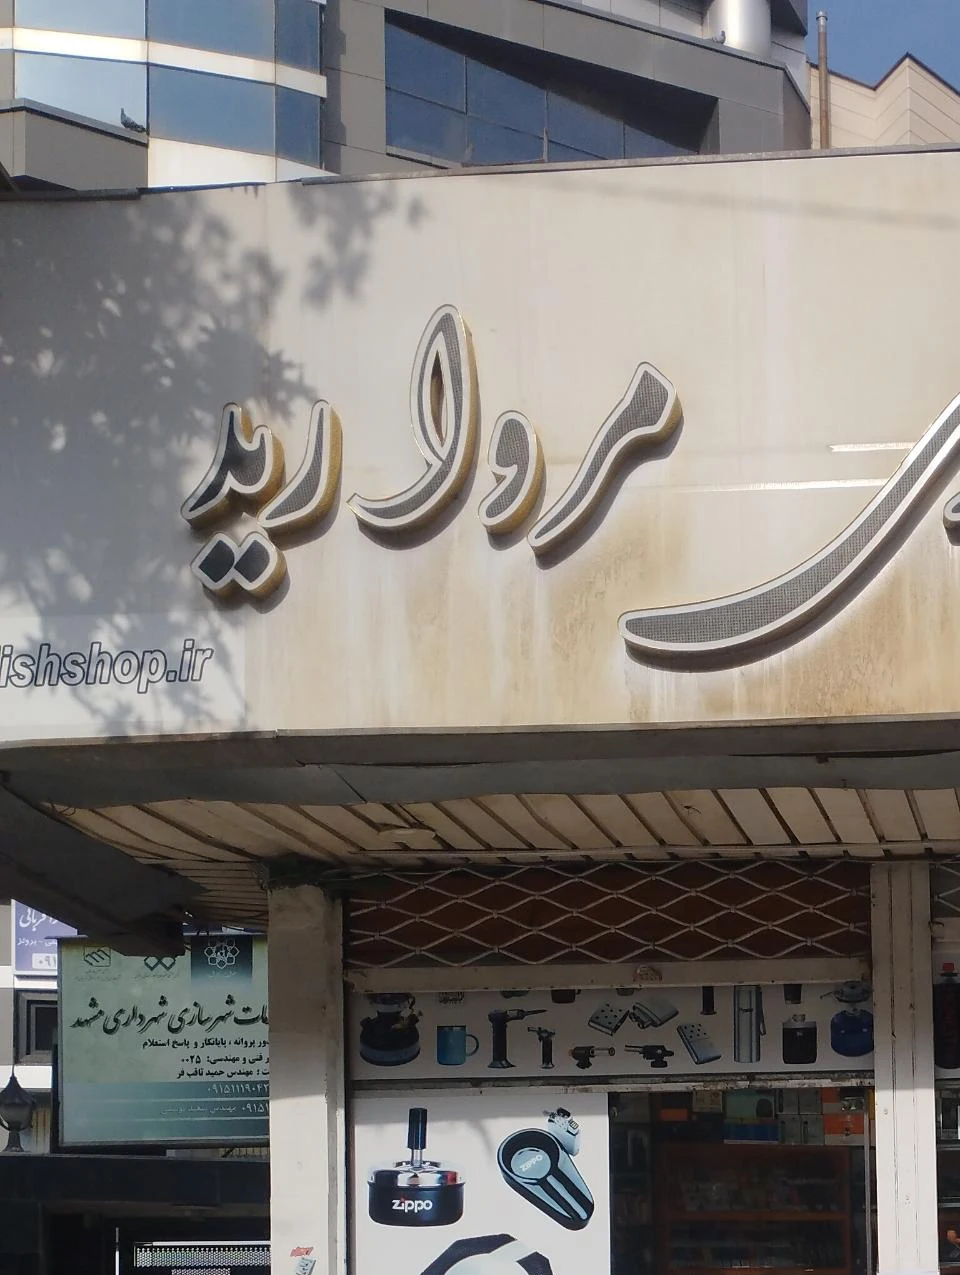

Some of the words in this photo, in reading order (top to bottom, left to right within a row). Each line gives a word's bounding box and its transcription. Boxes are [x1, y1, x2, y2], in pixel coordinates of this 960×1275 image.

[180, 304, 686, 602] مروارید
[0, 638, 215, 694] ishshop.ir
[68, 997, 105, 1028] مشهد
[102, 995, 168, 1035] شهرداری
